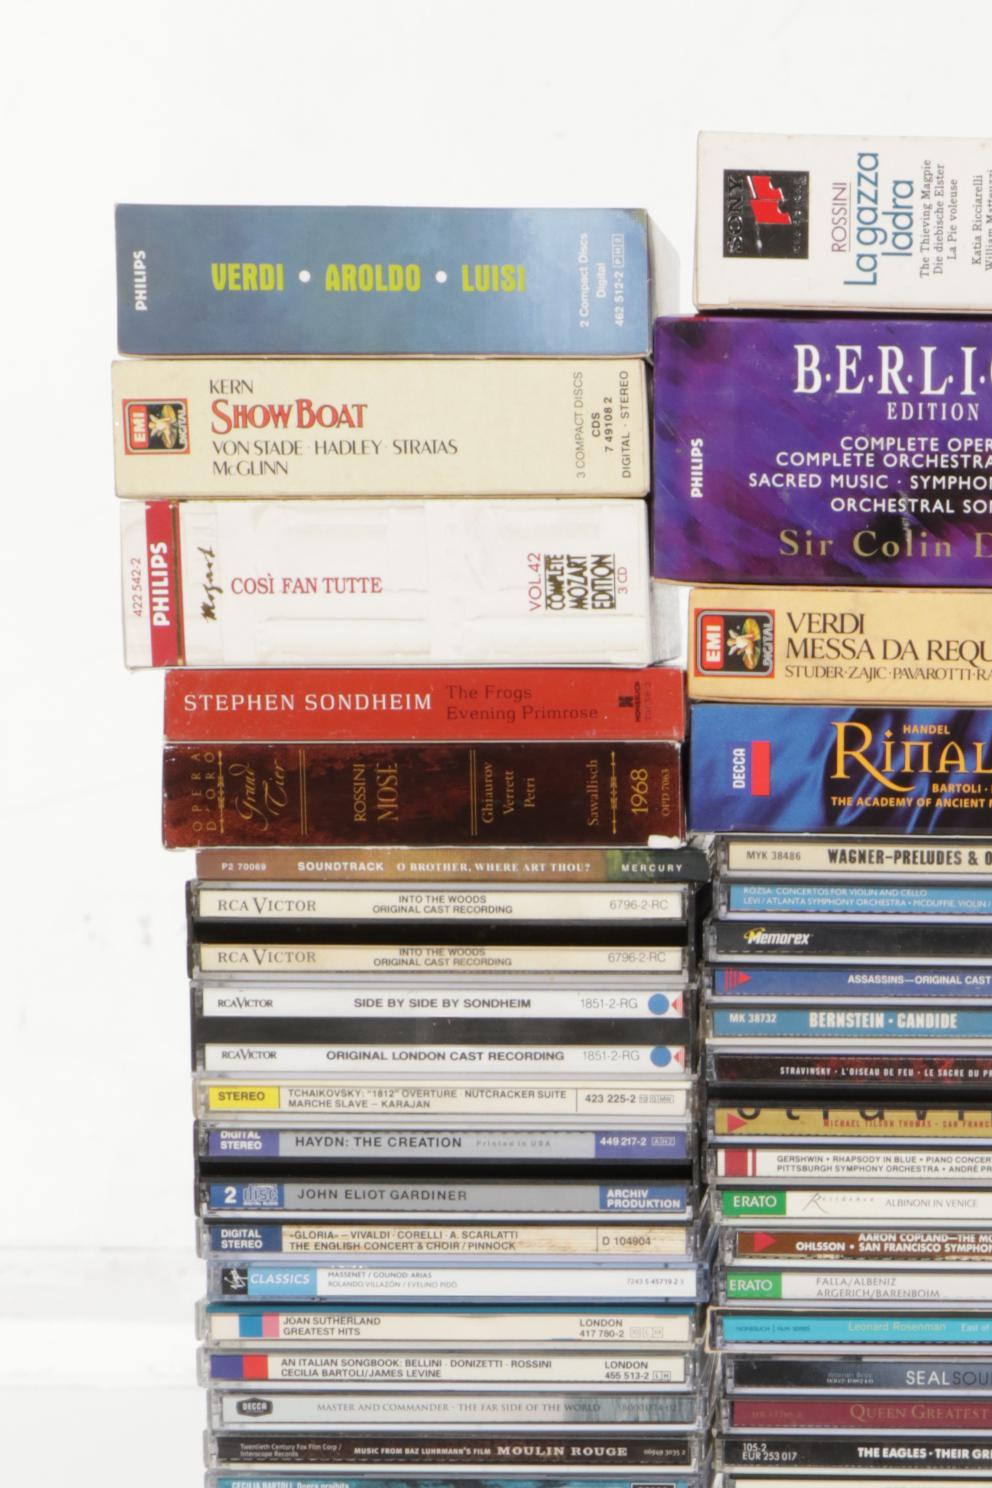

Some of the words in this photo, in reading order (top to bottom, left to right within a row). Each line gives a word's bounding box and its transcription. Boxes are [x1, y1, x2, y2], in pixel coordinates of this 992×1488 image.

[859, 152, 885, 249] gazza
[832, 181, 848, 253] ROSSINI
[881, 179, 914, 257] ladra
[212, 263, 284, 291] VERDI
[325, 265, 421, 292] AROLDO
[462, 265, 526, 292] LUISI
[844, 255, 878, 285] La
[135, 250, 146, 311] PHILIPS
[294, 398, 367, 428] BOAT
[887, 403, 979, 421] EDITION
[213, 460, 288, 476] McGLINN
[831, 498, 955, 513] ORCHESTRAL
[779, 530, 833, 557] Sir
[852, 531, 952, 558] Colin
[151, 542, 170, 627] PHILIPS
[231, 573, 274, 595] COSÌ
[282, 577, 318, 595] FAN
[322, 577, 382, 594] TUTTE
[786, 639, 874, 659] MESSA
[881, 640, 920, 660] DA
[184, 693, 295, 712] STEPHEN
[305, 693, 432, 711] SONDHEIM
[446, 706, 516, 723] Evening
[522, 705, 598, 720] Primrose
[903, 724, 950, 735] HANDEL
[733, 748, 746, 789] DECCA
[631, 769, 648, 816] 1968
[932, 783, 982, 794] BARTOLI
[298, 862, 384, 871] SOUNDTRACK
[218, 900, 248, 911] RCA
[253, 897, 317, 913] VICTOR
[354, 999, 383, 1008] SIDE
[387, 999, 404, 1008] BY
[409, 999, 438, 1008] SIDE
[442, 999, 459, 1008] BY
[463, 999, 531, 1008] SONDHEIM
[809, 1011, 884, 1029] BERNSTEIN
[898, 1013, 958, 1029] CANDIDE
[326, 1051, 388, 1061] ORIGINAL
[392, 1051, 445, 1061] LONDON
[450, 1051, 485, 1061] CAST
[489, 1051, 564, 1061] RECORDING
[218, 1092, 265, 1101] STEREO
[295, 1136, 350, 1149] HAYDN:
[355, 1136, 383, 1148] THE
[388, 1136, 462, 1149] CREATION
[298, 1189, 338, 1200] JOHN
[344, 1189, 385, 1200] ELIOT
[390, 1189, 467, 1201] GARDINER
[733, 1194, 777, 1208] ERATO
[283, 1316, 313, 1326] JOAN
[317, 1316, 381, 1326] SUTHERLAND
